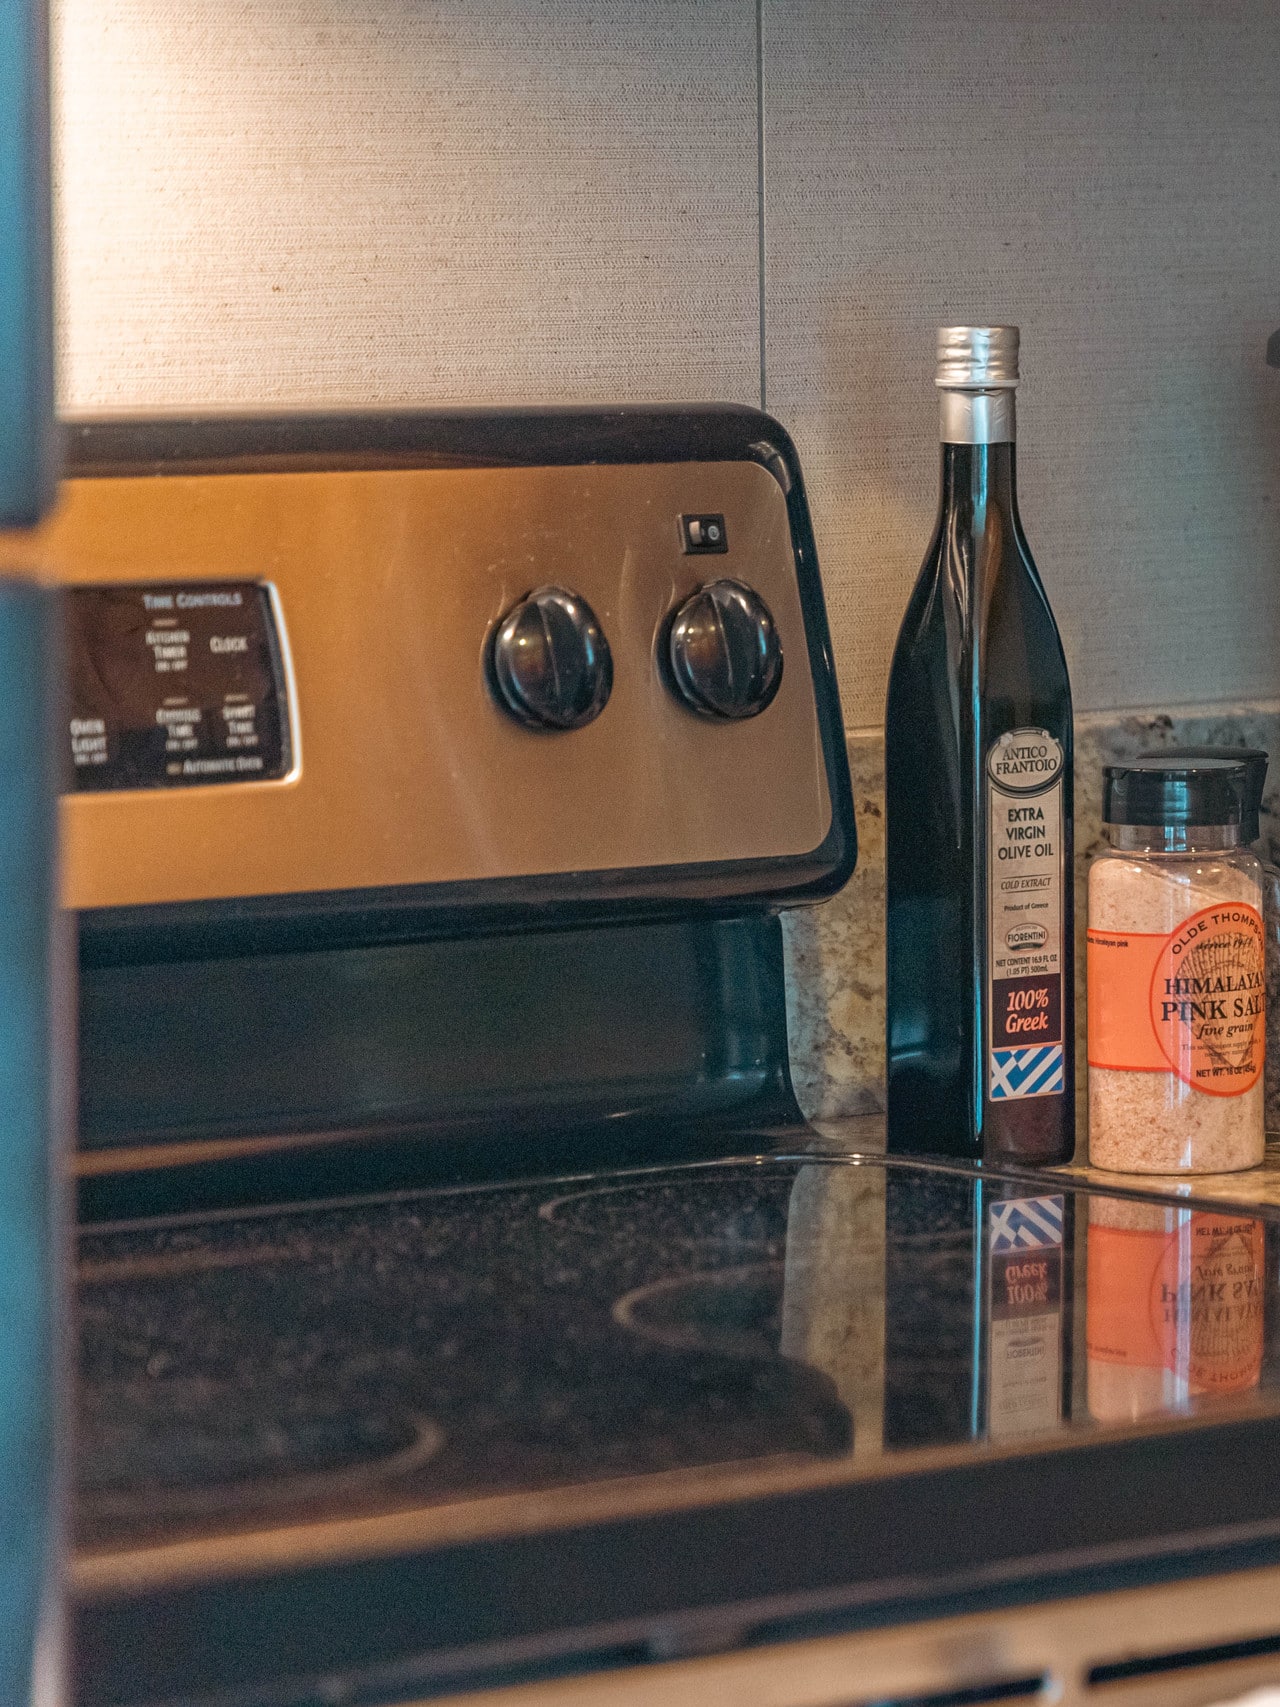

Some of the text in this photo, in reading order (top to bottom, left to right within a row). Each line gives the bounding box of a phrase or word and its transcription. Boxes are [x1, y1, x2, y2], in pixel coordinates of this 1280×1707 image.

[1002, 746, 1047, 761] ANTICO
[996, 758, 1057, 774] FRANTOIO
[1008, 807, 1044, 822] EXTRA
[1006, 825, 1046, 841] VIRGIN
[998, 843, 1054, 860] OLIVE OIL
[1001, 878, 1051, 890] COLD EXTRACT
[1008, 931, 1046, 942] FIORENTINI
[1172, 921, 1208, 954] OLDE
[1007, 988, 1049, 1011] 100%
[1161, 992, 1265, 1022] PINK SALT
[1005, 1012, 1049, 1034] Greek
[1196, 1020, 1253, 1040] fine grain
[1196, 1069, 1210, 1077] NET
